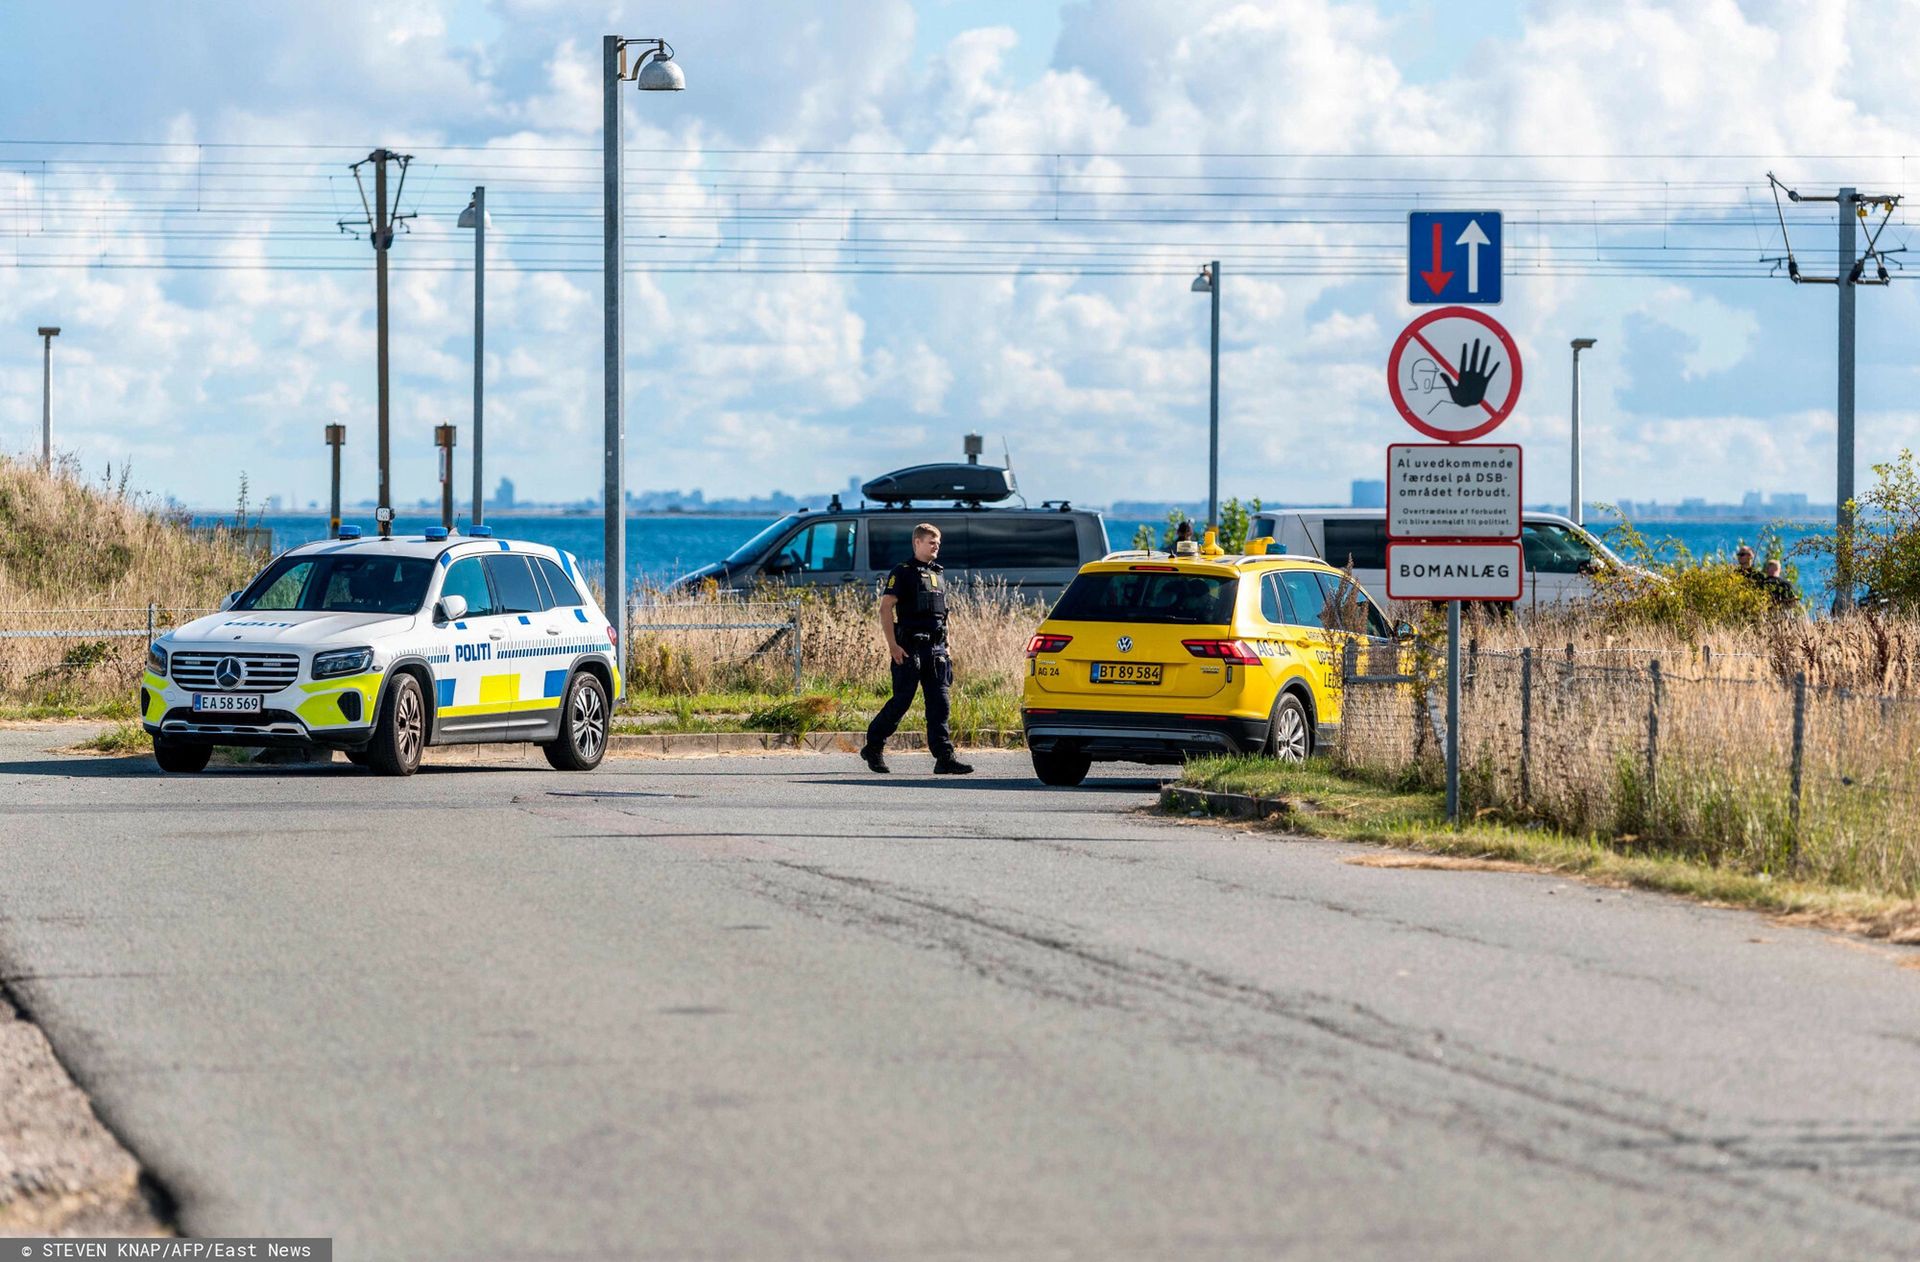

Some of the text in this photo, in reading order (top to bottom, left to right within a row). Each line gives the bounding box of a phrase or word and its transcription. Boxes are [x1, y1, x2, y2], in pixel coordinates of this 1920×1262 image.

[1397, 458, 1513, 469] Al uvedkommende
[1402, 472, 1452, 483] færdsel
[1456, 472, 1471, 484] på
[1399, 487, 1511, 497] området forbudt.
[1478, 518, 1512, 526] politiet.
[1400, 564, 1510, 578] BOMANLÆG
[455, 642, 491, 662] POLITI
[1256, 640, 1292, 656] AG 24
[1038, 667, 1060, 676] AG 24
[1100, 665, 1159, 679] BT 89 584
[202, 697, 217, 709] EA
[219, 697, 234, 709] 58
[236, 697, 258, 710] 569
